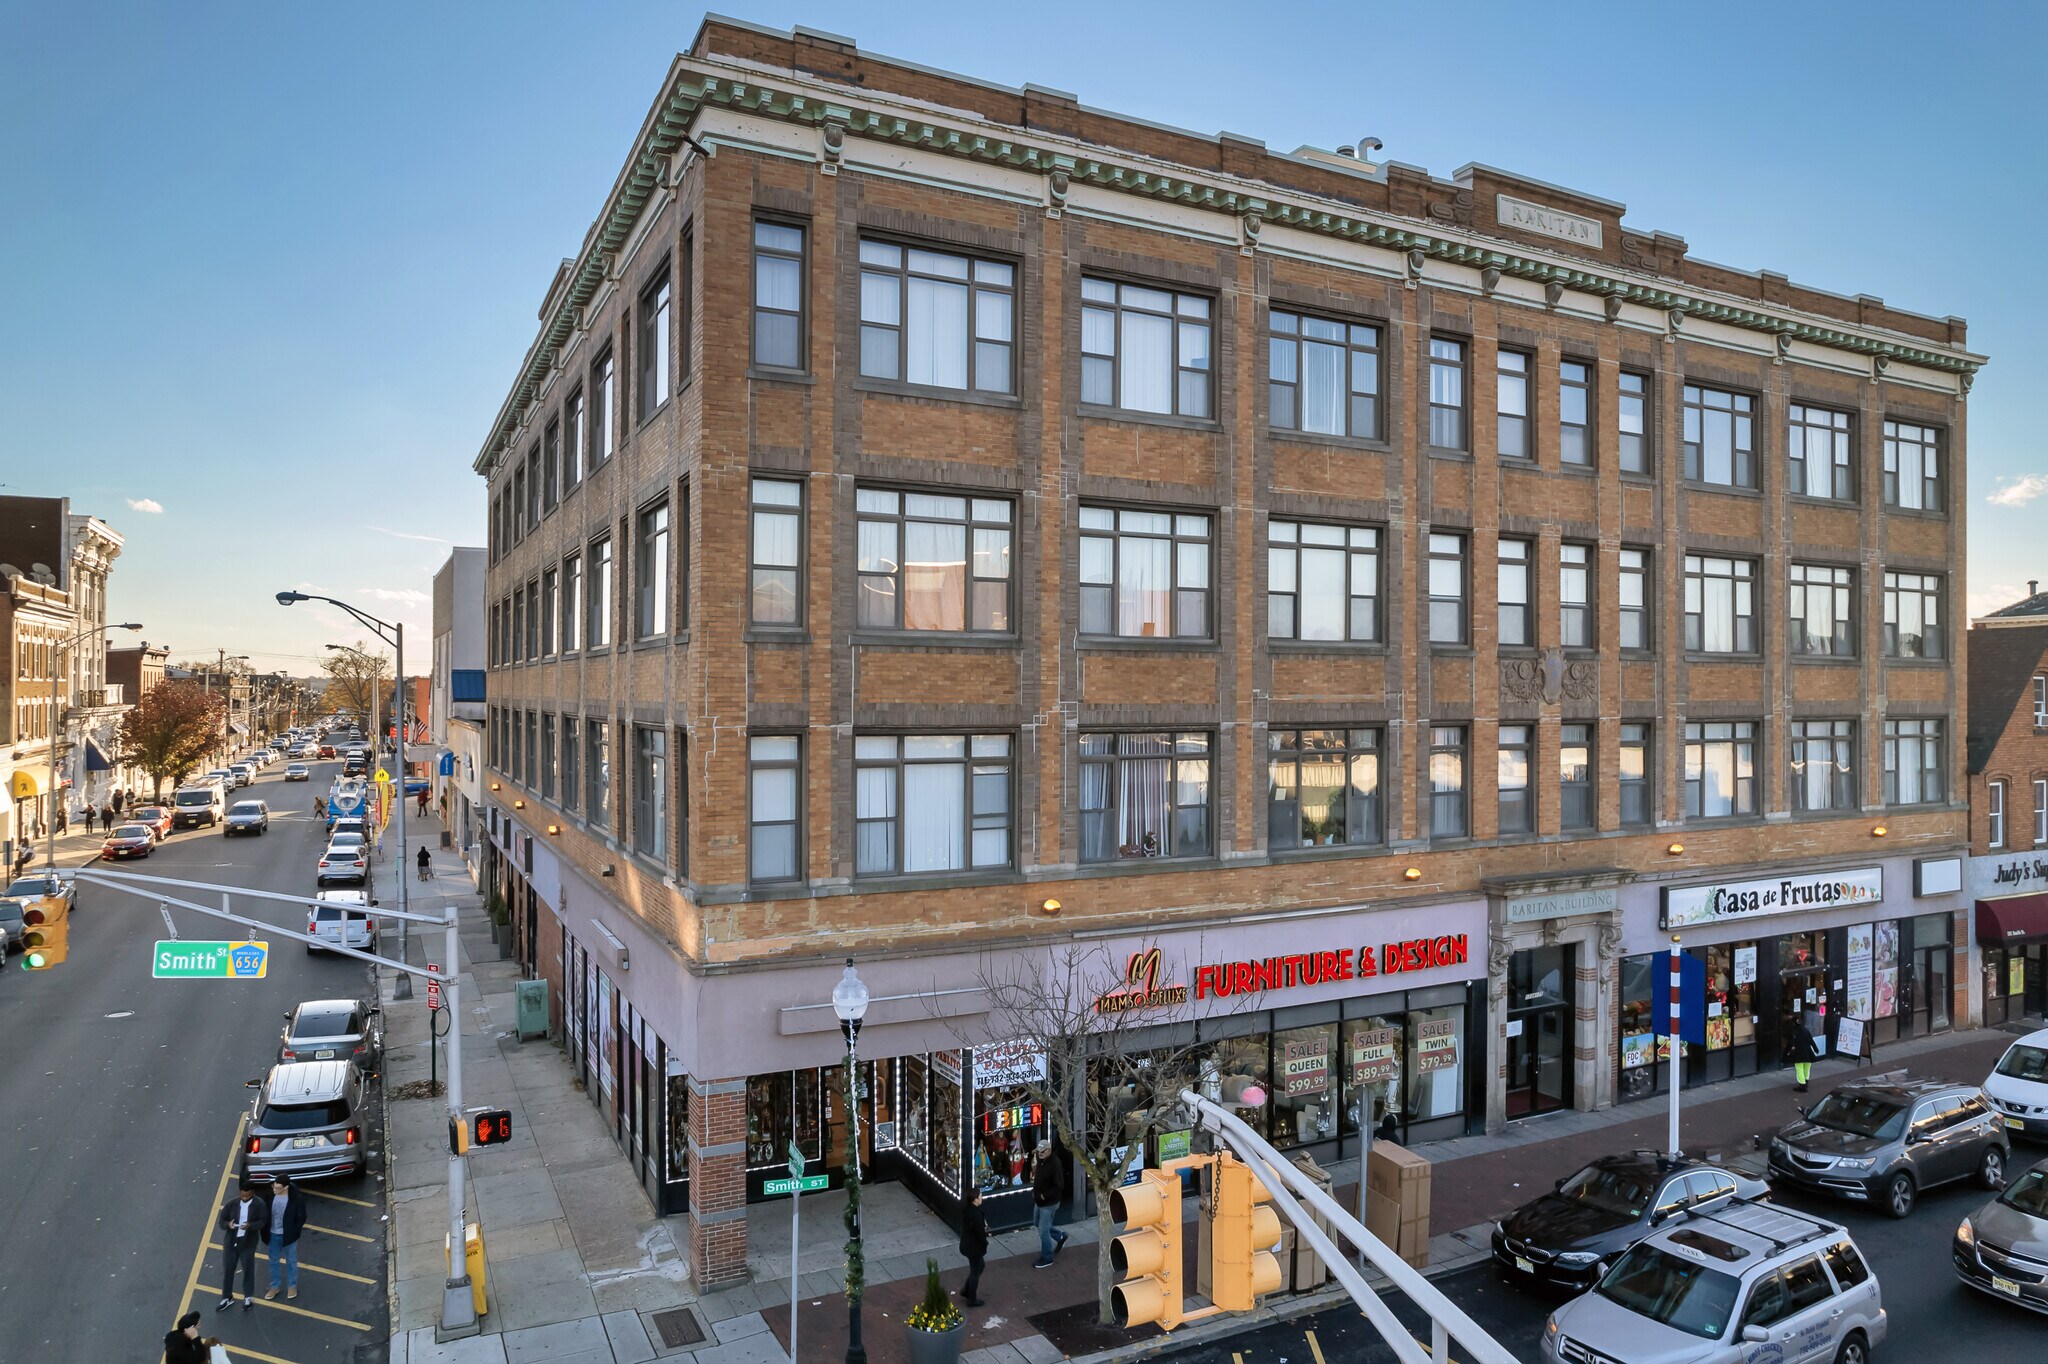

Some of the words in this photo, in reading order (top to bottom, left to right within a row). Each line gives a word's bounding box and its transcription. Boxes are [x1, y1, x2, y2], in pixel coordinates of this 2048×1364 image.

[1512, 205, 1589, 239] RARITAN
[1994, 861, 2030, 886] Judy's
[1512, 900, 1558, 917] RARITAN
[1565, 893, 1613, 909] BUILDING
[1713, 886, 1759, 915] Casa
[1763, 889, 1777, 906] de
[1780, 881, 1841, 906] Frutas
[159, 952, 216, 969] Smith
[235, 956, 259, 969] 656
[1195, 948, 1354, 1000] FURNITURE
[1360, 945, 1377, 978] &
[1382, 934, 1468, 975] DESIGN
[1099, 993, 1146, 1013] MAMBO
[1150, 987, 1187, 1006] DELUXE
[1422, 1023, 1452, 1037] SALE!
[1358, 1032, 1390, 1047] SALE!
[1425, 1038, 1448, 1050] TWIN
[1290, 1043, 1324, 1059] SALE!
[1362, 1049, 1384, 1061] FULL
[1627, 1051, 1639, 1061] FDC
[1289, 1058, 1324, 1073] QUEEN
[1420, 1054, 1452, 1070] $79.99
[1356, 1064, 1390, 1081] $89.99
[1288, 1076, 1324, 1093] $99.99
[766, 1180, 803, 1192] Smith
[811, 1179, 824, 1187] ST
[466, 1250, 478, 1258] ATIS
